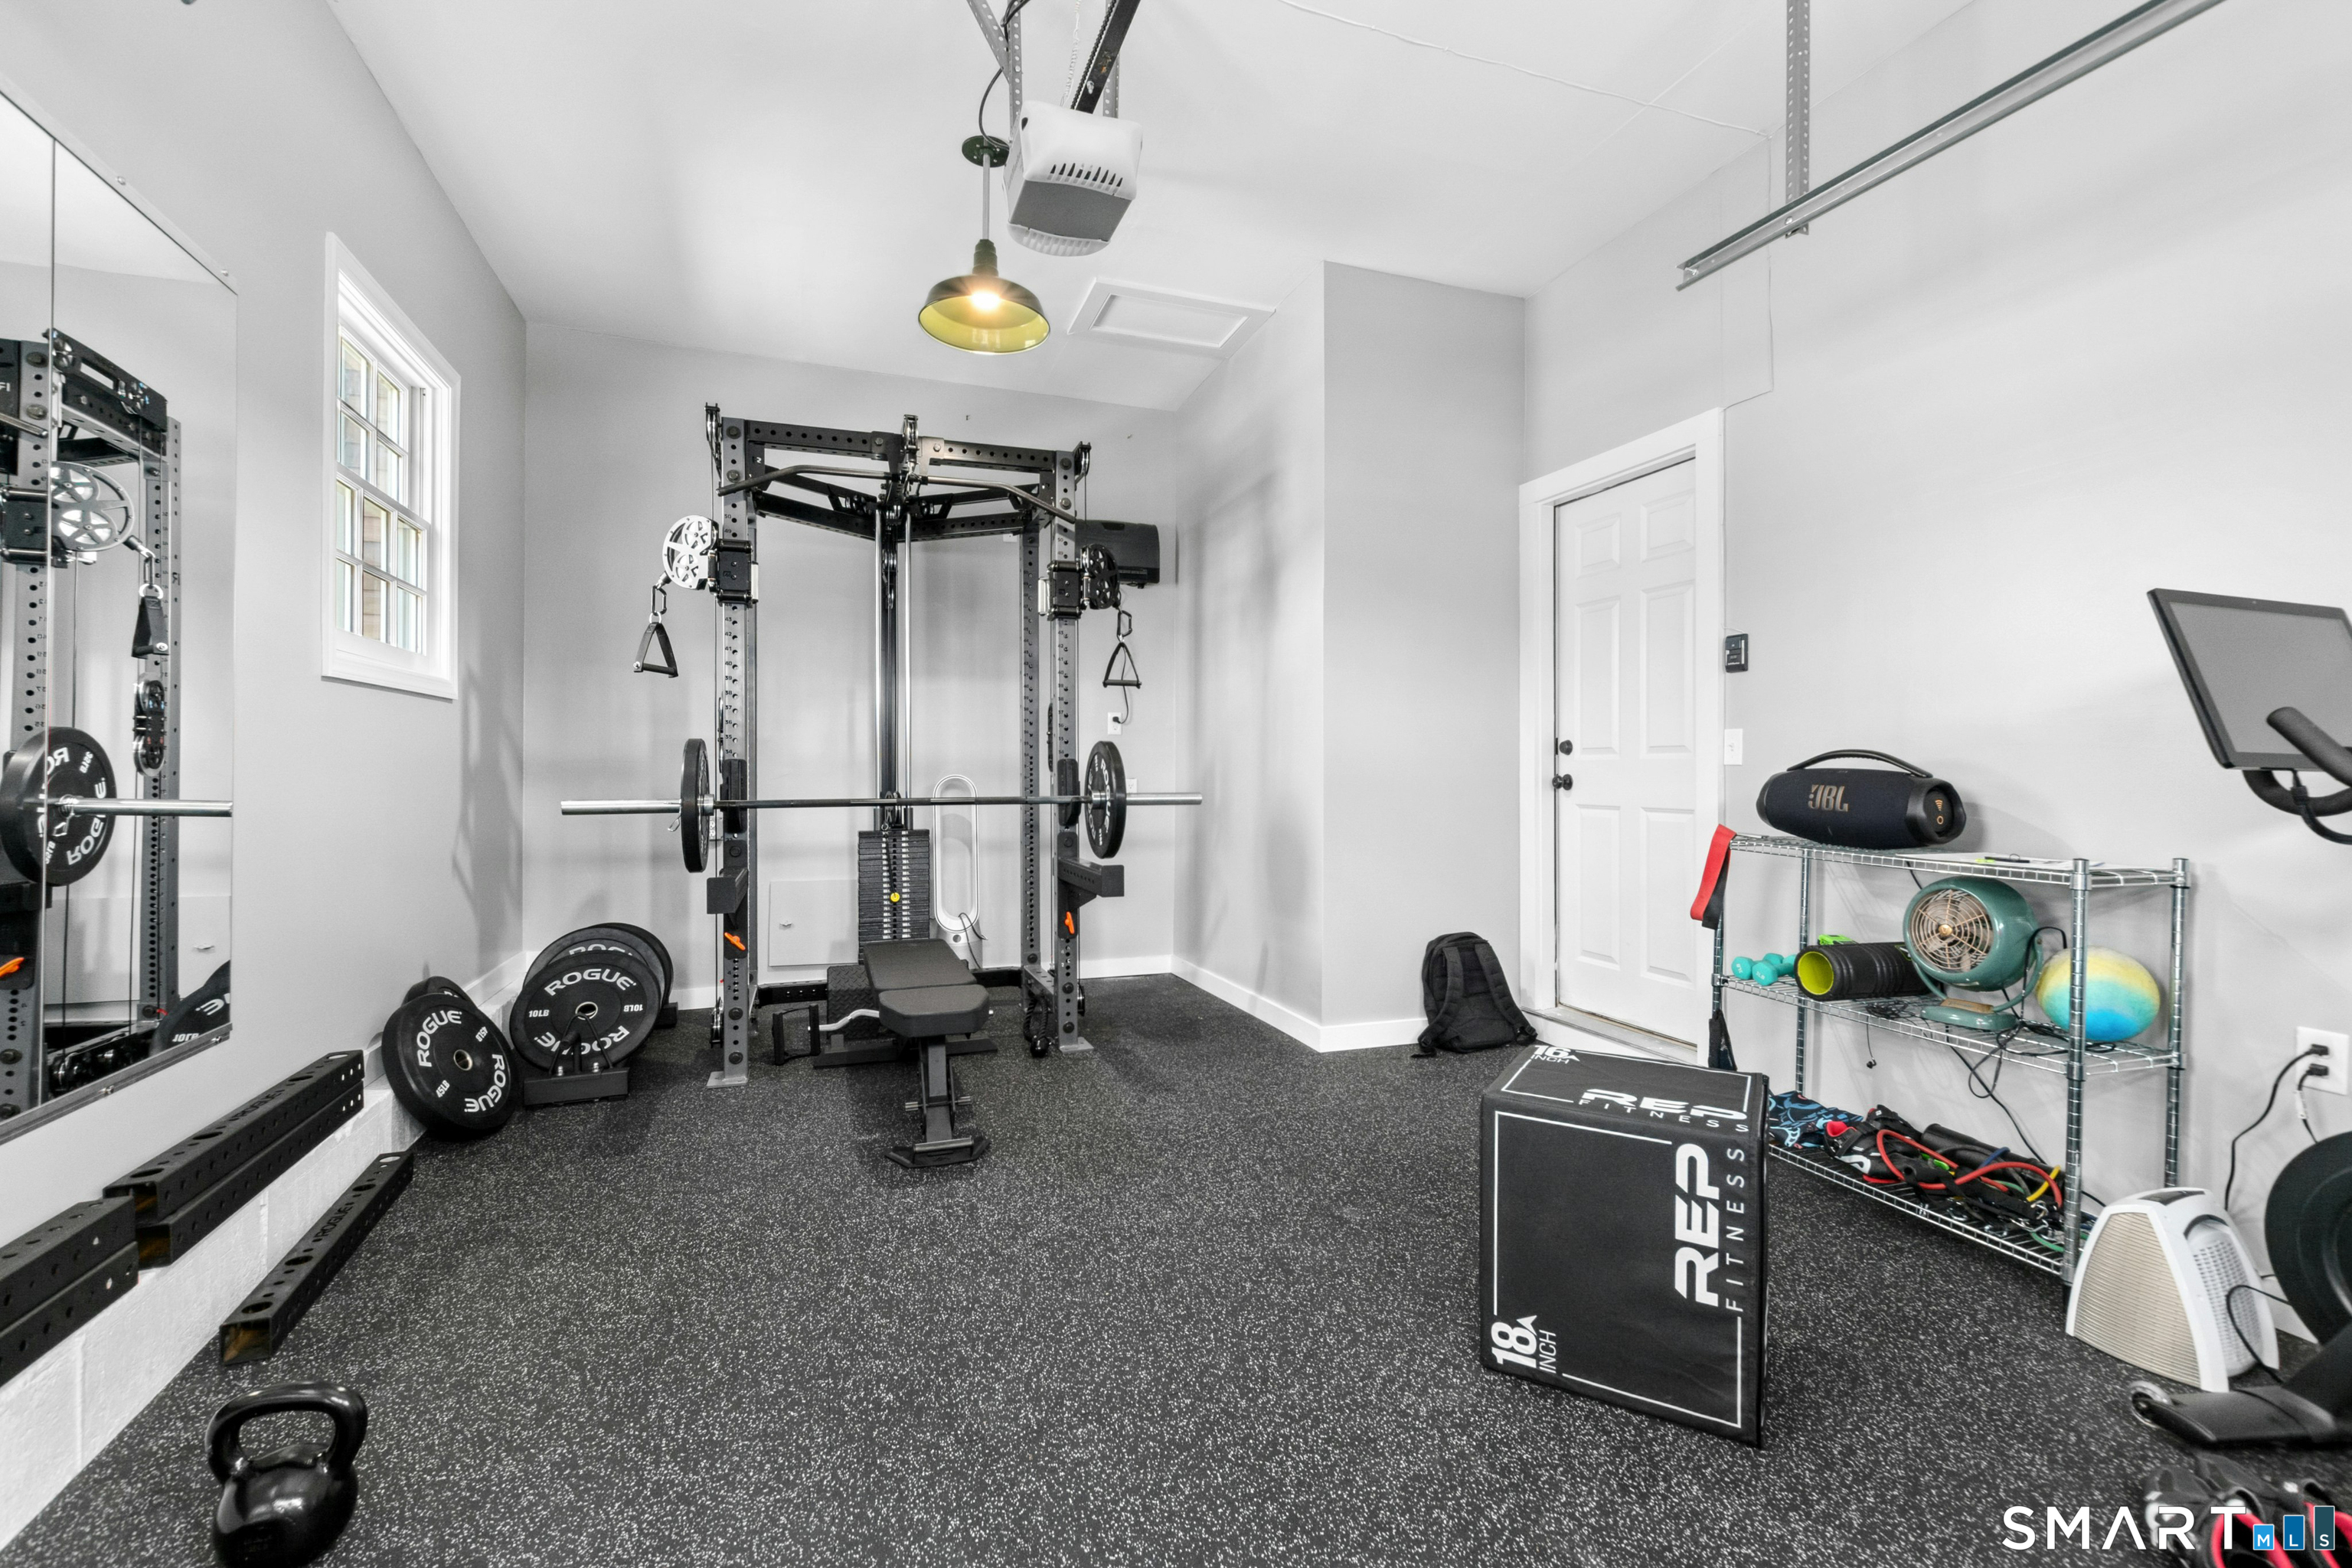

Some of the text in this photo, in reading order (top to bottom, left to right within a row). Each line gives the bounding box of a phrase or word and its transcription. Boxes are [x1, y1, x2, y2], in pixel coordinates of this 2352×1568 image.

[1100, 758, 1111, 833] ROGUE
[1808, 784, 1849, 812] JBL
[544, 968, 637, 996] ROGUE
[528, 1009, 550, 1018] 10LB
[623, 1004, 644, 1012] 10LB
[416, 1010, 462, 1067] ROGUE
[475, 1026, 488, 1042] 45LB
[1530, 1054, 1570, 1064] INCH
[1534, 1044, 1571, 1059] 16
[436, 1080, 450, 1098] 45LB
[464, 1054, 506, 1112] ROGUE
[1579, 1099, 1749, 1132] FITNESS
[1582, 1088, 1748, 1120] REP
[1674, 1143, 1720, 1308] REP
[1725, 1147, 1746, 1313] FITNESS
[1491, 1321, 1537, 1369] 18
[1539, 1329, 1557, 1374] INCH
